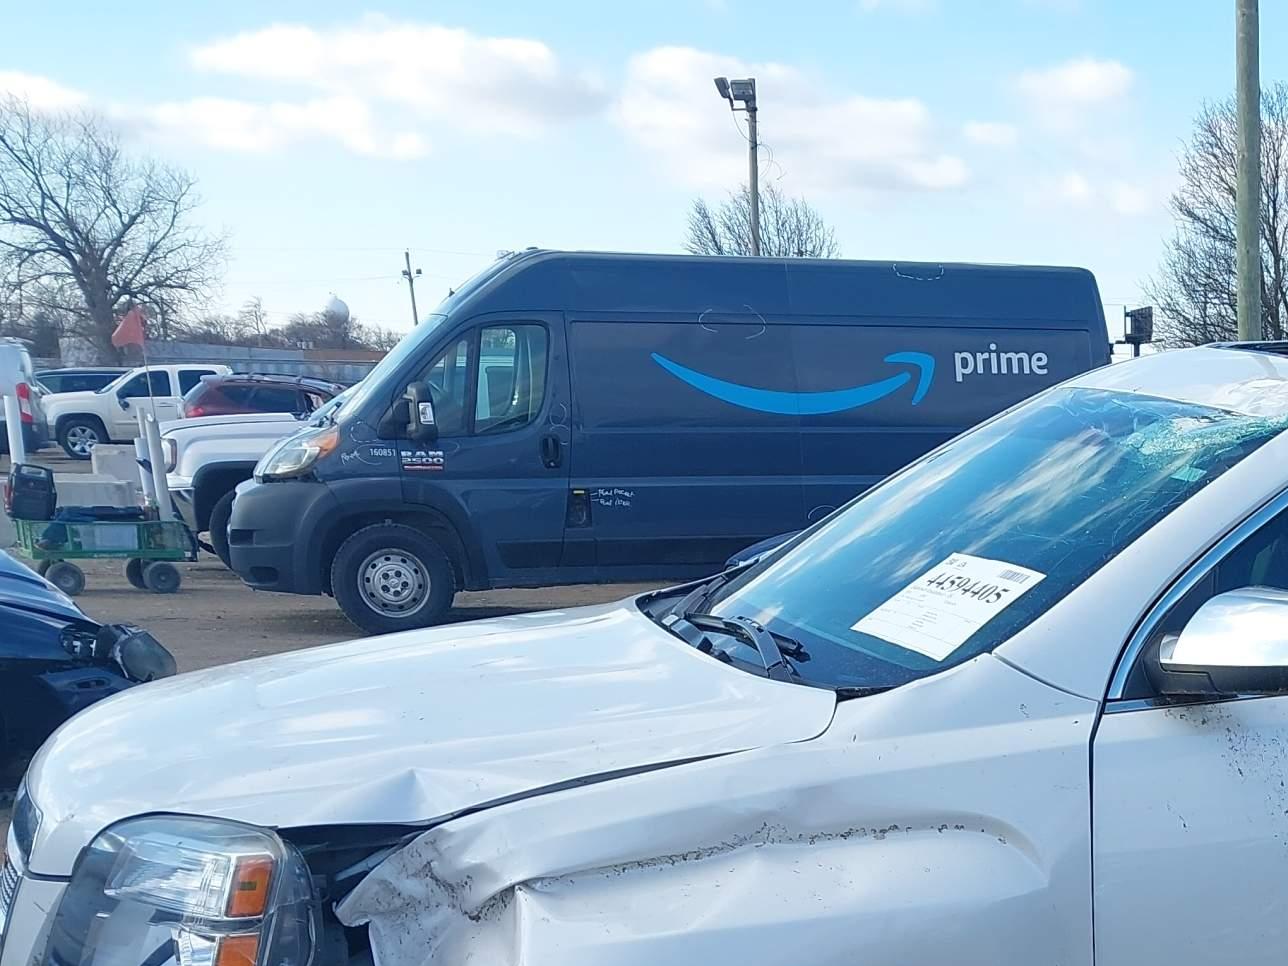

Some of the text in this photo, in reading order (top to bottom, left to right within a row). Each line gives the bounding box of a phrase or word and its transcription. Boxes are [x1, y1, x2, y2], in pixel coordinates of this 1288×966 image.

[954, 343, 1048, 382] prime
[369, 448, 396, 457] 160851
[926, 573, 1011, 603] 44594405
